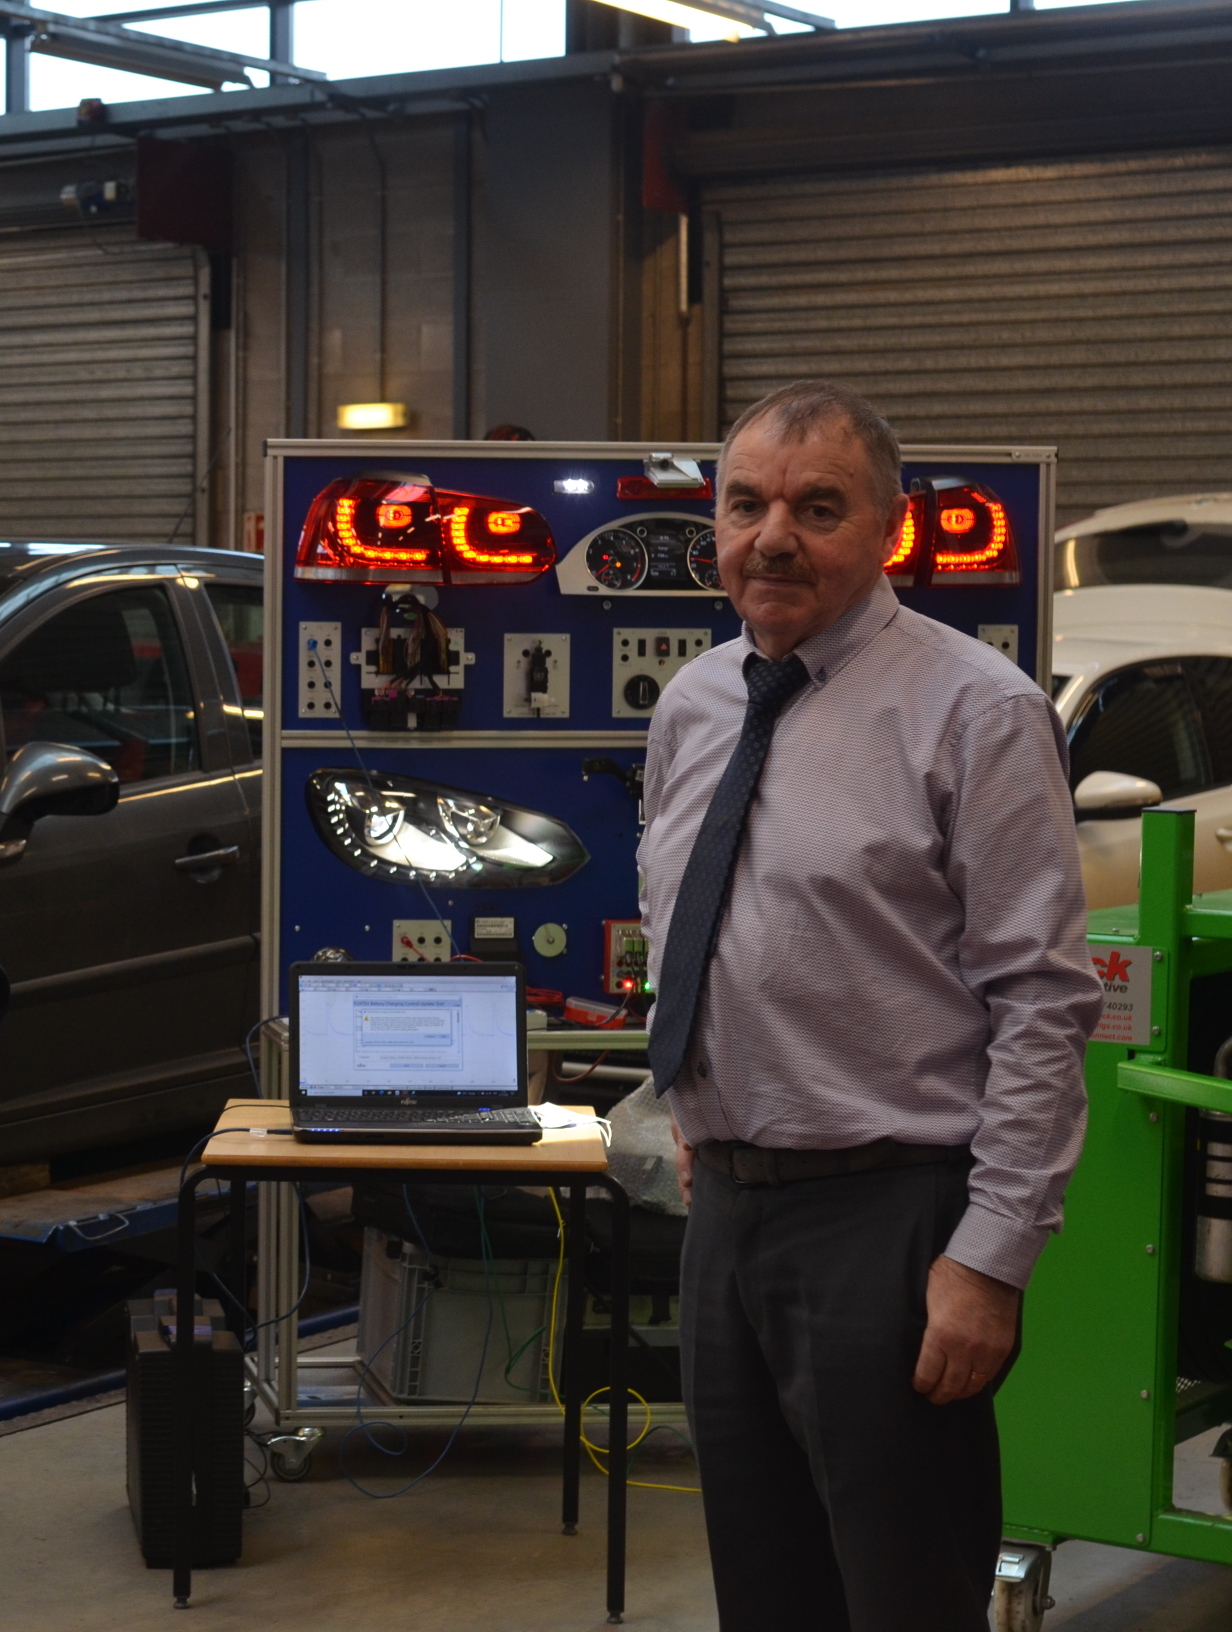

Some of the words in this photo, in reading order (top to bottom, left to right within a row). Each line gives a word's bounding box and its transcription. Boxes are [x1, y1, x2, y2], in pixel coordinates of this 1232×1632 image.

[1092, 951, 1132, 982] ck
[1104, 981, 1128, 993] tive
[1102, 1013, 1132, 1021] ck.co.uk
